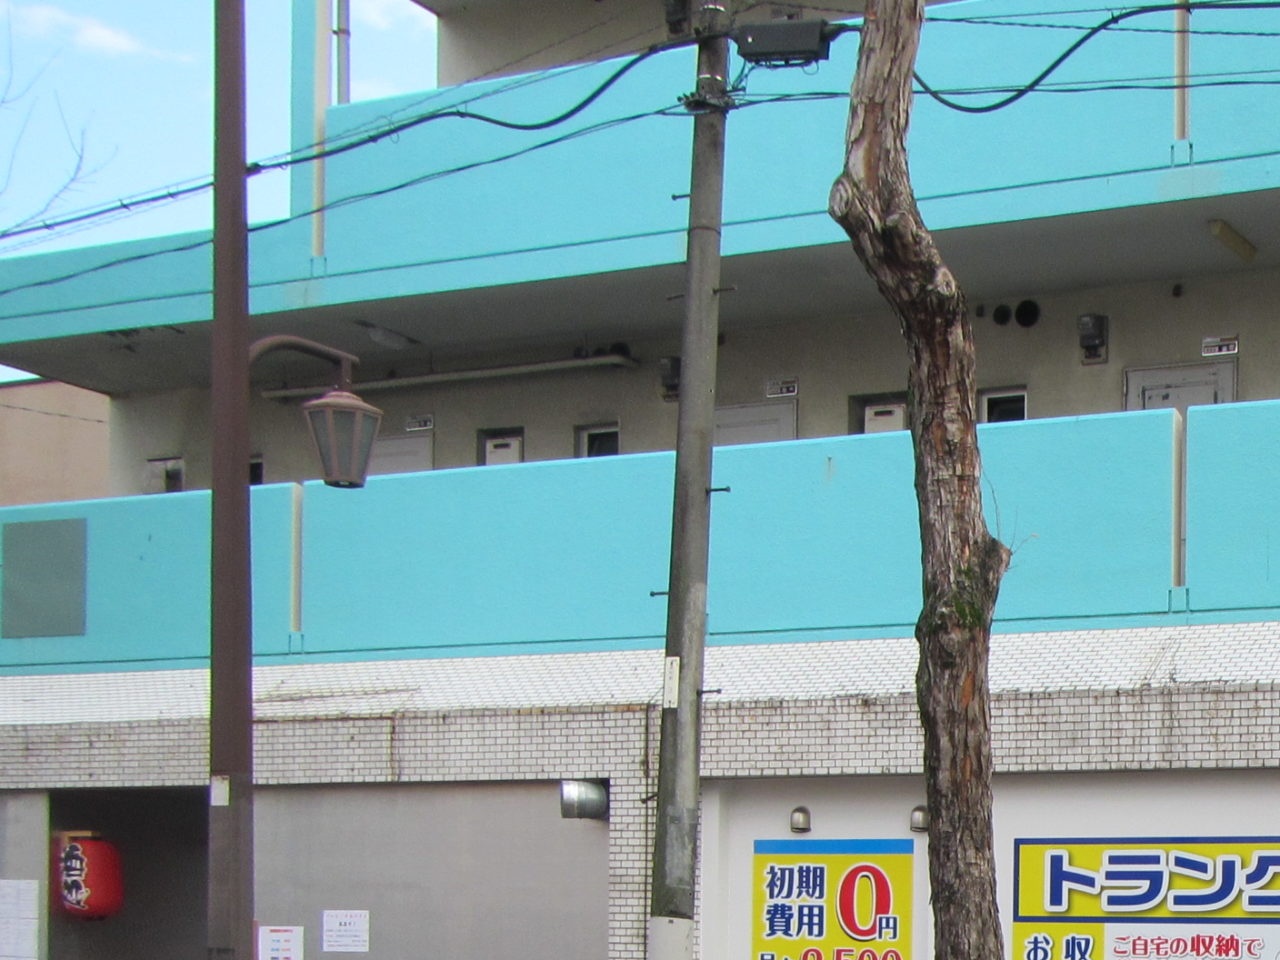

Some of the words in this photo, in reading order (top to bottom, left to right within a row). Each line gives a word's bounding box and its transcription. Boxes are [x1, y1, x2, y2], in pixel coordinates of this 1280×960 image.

[765, 865, 825, 899] 初期
[765, 903, 825, 937] 費用
[1112, 934, 1263, 958] ご自宅の収納で
